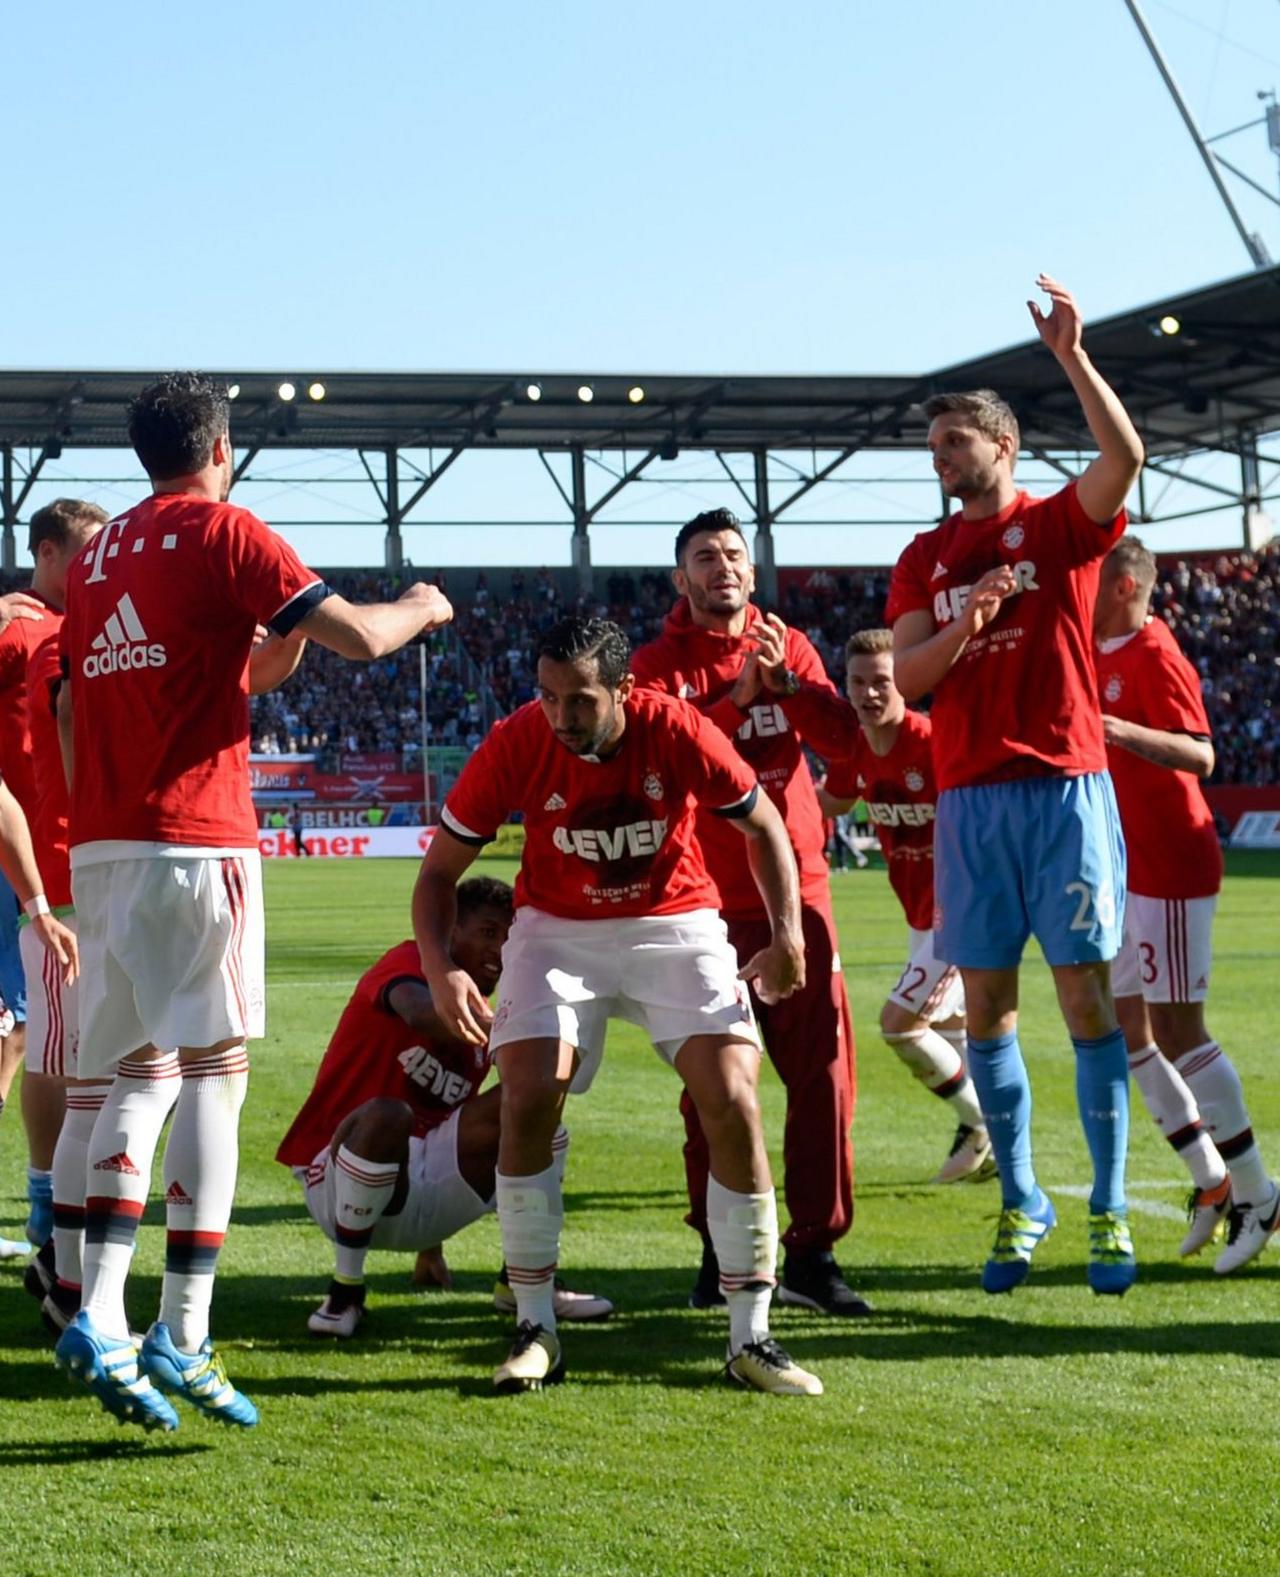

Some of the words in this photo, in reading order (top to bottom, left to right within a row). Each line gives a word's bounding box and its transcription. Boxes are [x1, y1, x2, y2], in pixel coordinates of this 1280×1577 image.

[82, 641, 168, 679] adidas
[258, 830, 370, 858] ckner
[1065, 879, 1116, 931] 26
